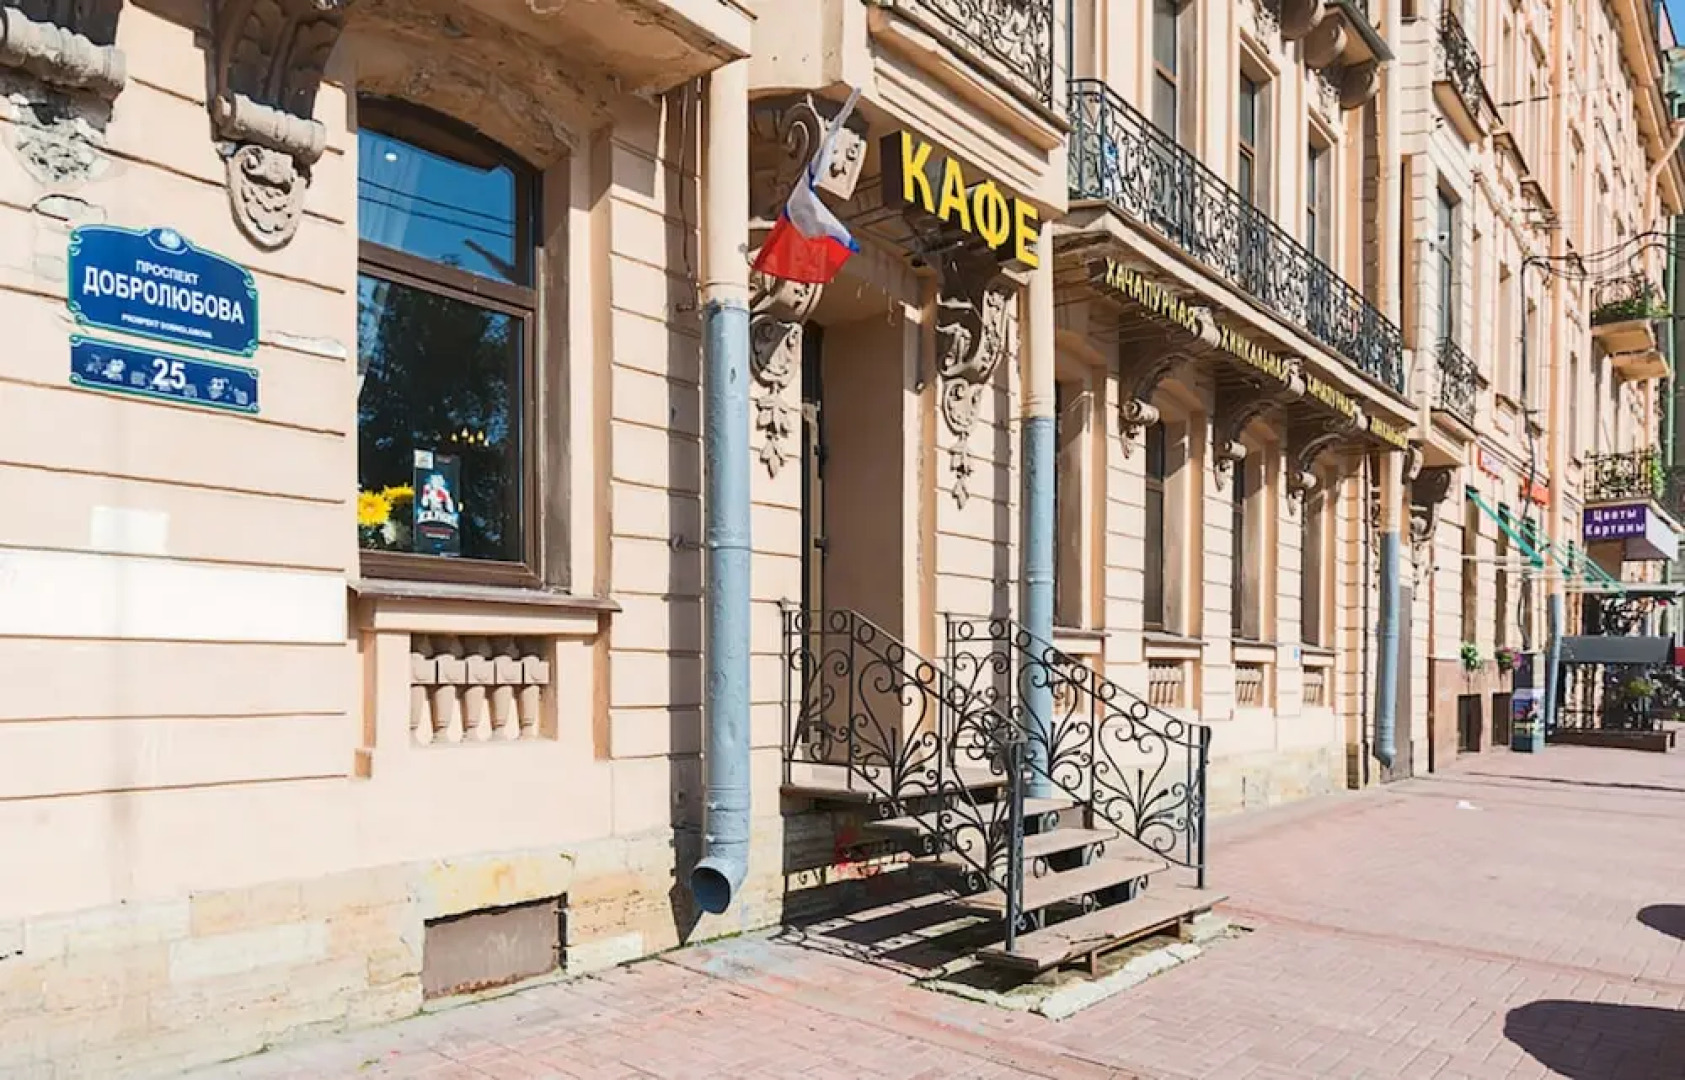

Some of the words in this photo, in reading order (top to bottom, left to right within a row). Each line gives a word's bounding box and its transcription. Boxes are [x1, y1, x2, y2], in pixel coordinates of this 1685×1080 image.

[901, 129, 1040, 269] КАФЕ
[135, 258, 200, 286] ПРОСПЕКТ
[82, 264, 246, 325] ДОБРОЛЮБОВА
[1106, 255, 1198, 337] ХАЧАПУРНАЯ
[152, 358, 187, 389] 25
[1585, 523, 1645, 537] Картины
[1593, 508, 1637, 523] Цветы
